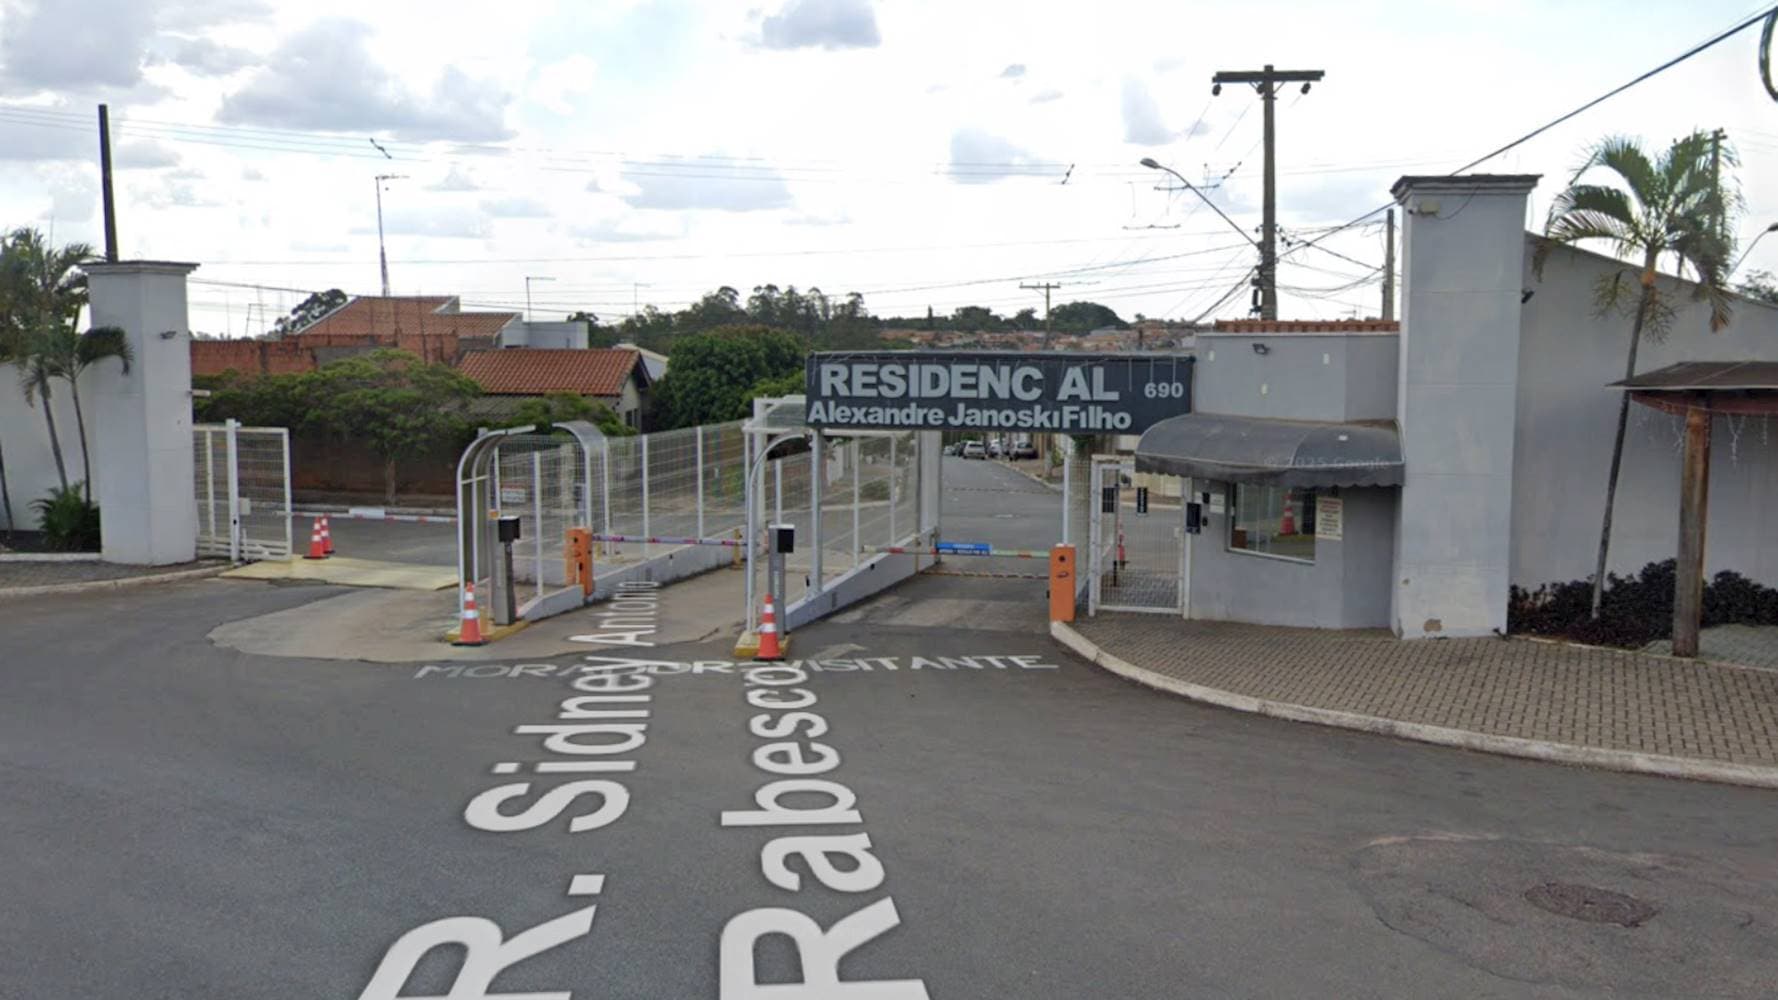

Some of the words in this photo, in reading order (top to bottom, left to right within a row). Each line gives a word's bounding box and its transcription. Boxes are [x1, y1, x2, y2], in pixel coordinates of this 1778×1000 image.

[1144, 382, 1184, 399] 690
[807, 401, 945, 426] Alexandre
[947, 402, 1060, 428] Janoski
[1062, 405, 1132, 430] Filho
